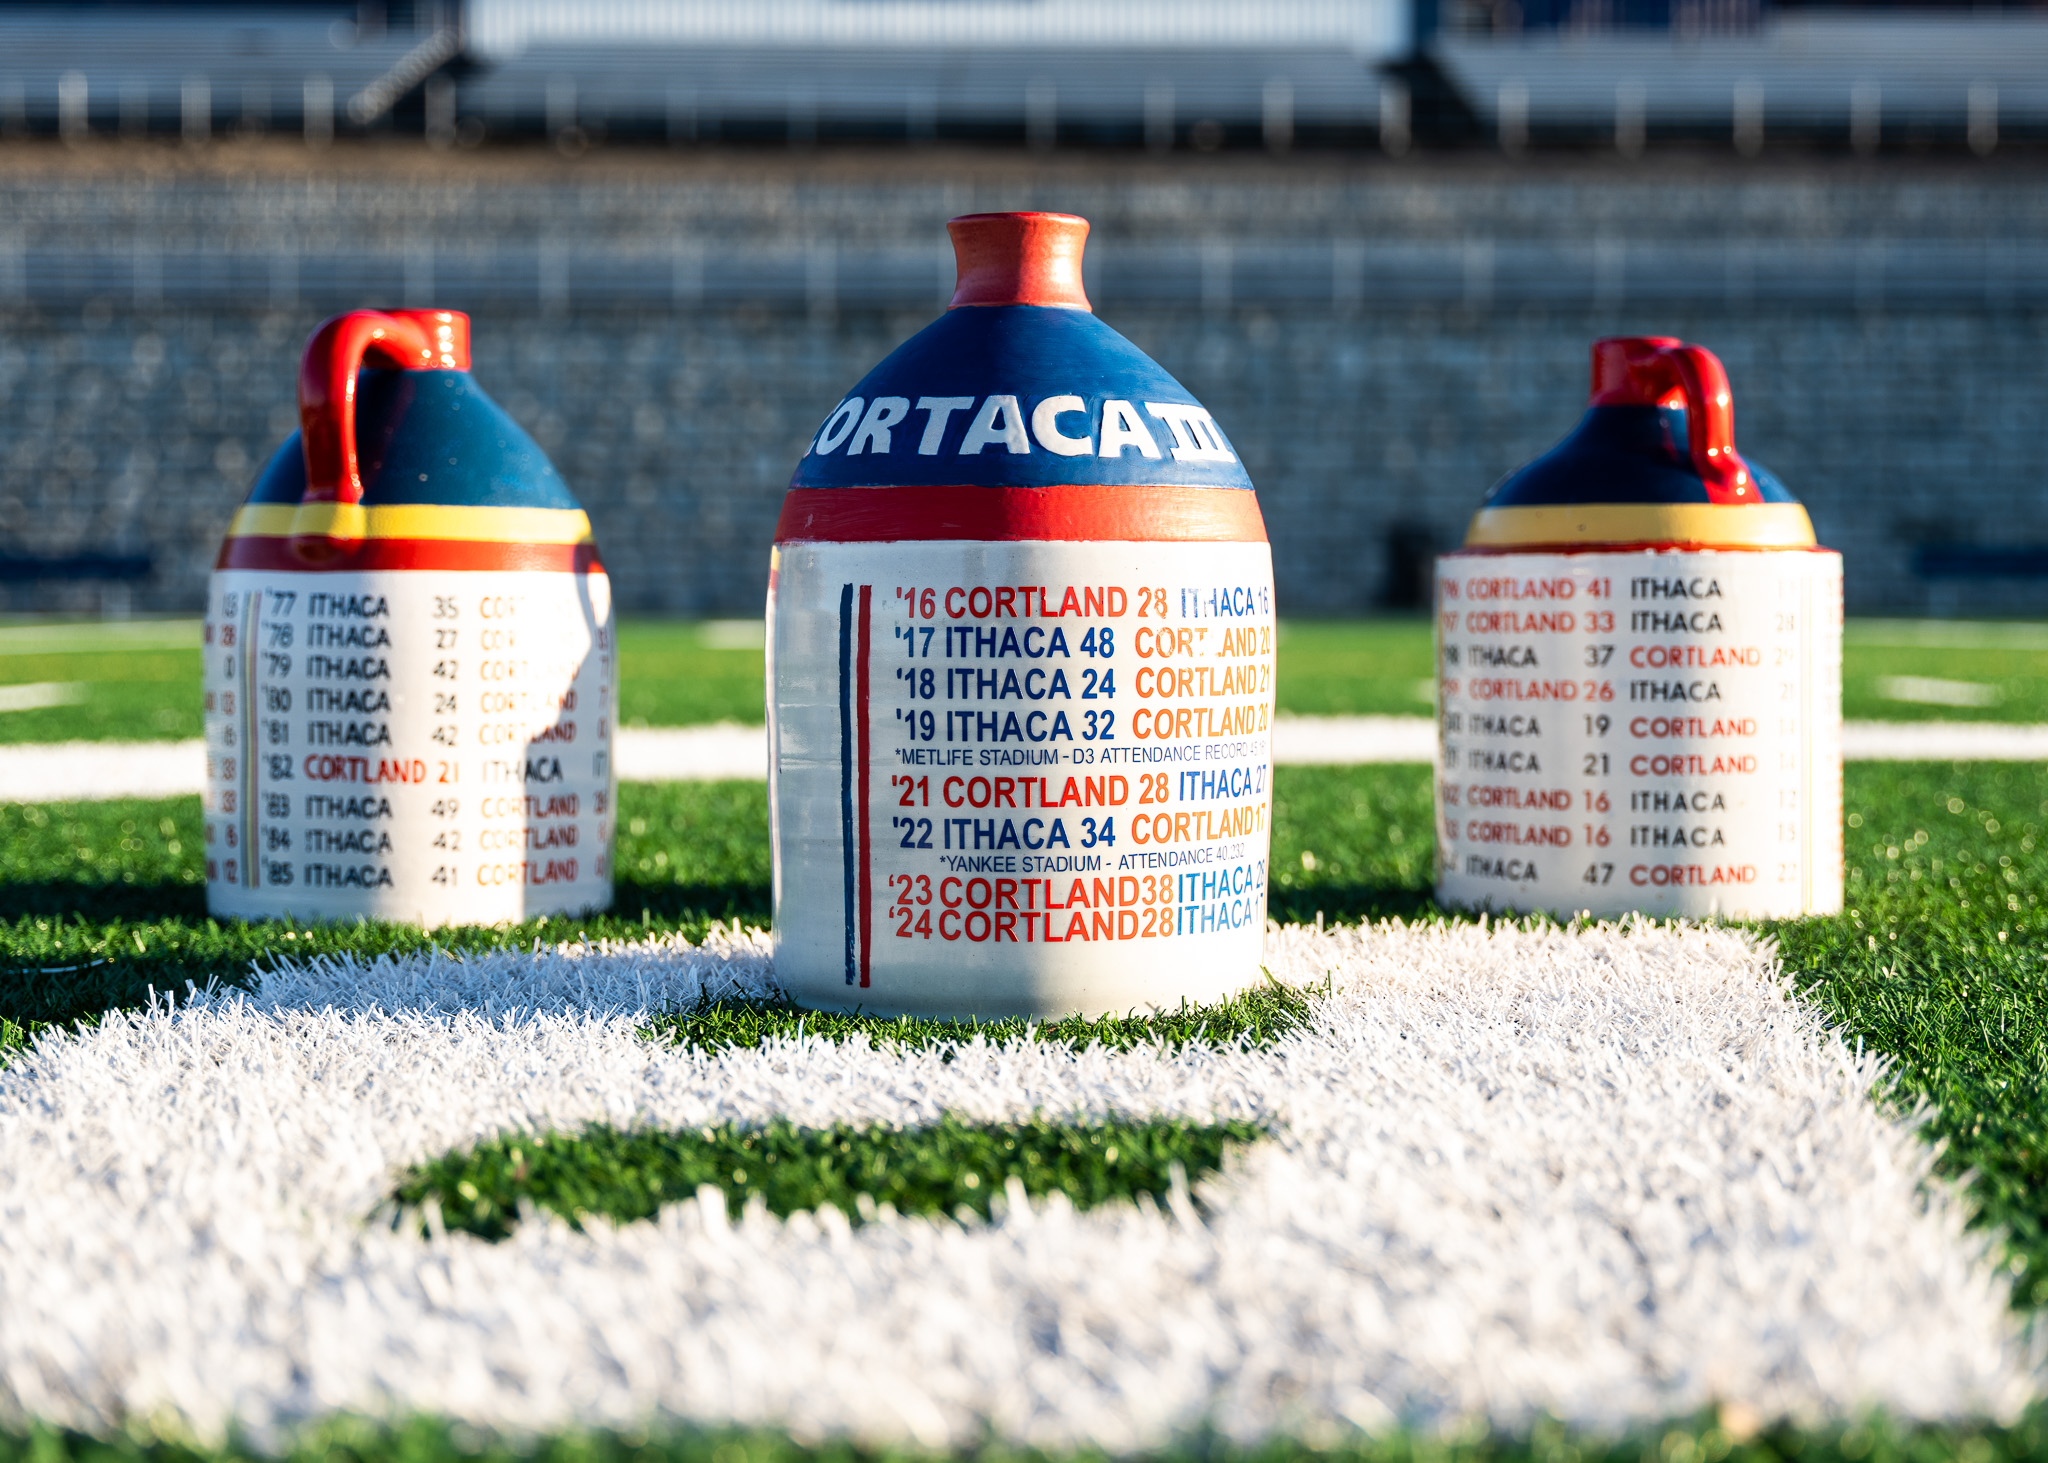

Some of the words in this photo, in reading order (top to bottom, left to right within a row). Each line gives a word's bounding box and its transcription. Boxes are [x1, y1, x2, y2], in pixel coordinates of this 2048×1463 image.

[266, 586, 296, 617] '77
[308, 593, 390, 618] ITHACA
[432, 595, 458, 619] 35
[896, 586, 936, 619] '16
[944, 586, 1128, 619] CORTLAND
[1137, 586, 1168, 620] 28
[1180, 586, 1255, 619] ITHACA
[1258, 586, 1269, 617] 16
[1466, 577, 1575, 600] CORTLAND
[1585, 577, 1612, 599] 41
[1630, 577, 1723, 600] ITHACA
[261, 619, 294, 648] '78
[308, 624, 391, 650] ITHACA
[436, 628, 457, 650] 27
[1466, 611, 1577, 634] CORTLAND
[1583, 611, 1616, 634] 33
[1630, 610, 1725, 634] ITHACA
[895, 626, 935, 658] '17
[946, 626, 1071, 659] ITHACA
[1080, 626, 1115, 659] 48
[1260, 625, 1271, 656] 20
[1468, 644, 1539, 668] ITHACA
[1584, 645, 1615, 668] 37
[1629, 645, 1760, 669] CORTLAND
[261, 650, 292, 679] '79
[307, 654, 391, 681] ITHACA
[432, 657, 458, 681] 42
[896, 667, 935, 700] '18
[947, 668, 1072, 700] ITHACA
[1081, 668, 1116, 700] 24
[1135, 664, 1257, 698] CORTLAND
[1260, 663, 1271, 693] 21
[261, 682, 293, 713] '80
[307, 686, 391, 714] ITHACA
[434, 691, 457, 714] 24
[1469, 678, 1578, 702] CORTLAND
[1582, 679, 1616, 702] 26
[1630, 679, 1722, 702] ITHACA
[261, 716, 290, 745] '81
[307, 720, 391, 747] ITHACA
[431, 724, 458, 748] 42
[896, 708, 935, 742] '19
[947, 710, 1074, 743] ITHACA
[1081, 709, 1115, 741] 32
[1132, 705, 1256, 740] CORTLAND
[1258, 702, 1269, 732] 20
[1468, 713, 1542, 738] ITHACA
[1584, 713, 1611, 737] 19
[1629, 716, 1758, 739] CORTLAND
[262, 751, 295, 782] '82
[303, 753, 426, 784] CORTLAND
[437, 760, 459, 784] 21
[482, 754, 566, 785] ITHACA
[979, 748, 1059, 766] STADIUM
[1073, 747, 1095, 764] D3
[1100, 745, 1201, 764] ATTENDANCE
[1205, 741, 1248, 760] RECORD
[1467, 750, 1541, 775] ITHACA
[1583, 752, 1611, 776] 21
[1629, 754, 1757, 777] CORTLAND
[891, 775, 929, 807] '21
[942, 775, 1129, 808] CORTLAND
[1138, 772, 1170, 804] 28
[1179, 767, 1252, 801] ITHACA
[1255, 764, 1267, 794] 27
[1466, 785, 1572, 811] CORTLAND
[1583, 789, 1611, 812] 16
[1630, 790, 1726, 813] ITHACA
[305, 795, 393, 821] ITHACA
[431, 796, 458, 821] 49
[480, 791, 580, 821] CORTLAND
[305, 828, 392, 855] ITHACA
[432, 829, 461, 854] 42
[479, 823, 580, 851] CORTLAND
[892, 816, 933, 849] '22
[943, 818, 1071, 850] ITHACA
[1080, 816, 1116, 848] 34
[1131, 806, 1254, 846] CORTLAND
[1255, 802, 1266, 833] 17
[1466, 819, 1572, 848] CORTLAND
[1584, 824, 1611, 848] 16
[1630, 825, 1726, 848] ITHACA
[304, 862, 394, 889] ITHACA
[431, 864, 457, 888] 41
[476, 855, 579, 887] CORTLAND
[1022, 854, 1102, 873] STADIUM
[1118, 847, 1213, 870] ATTENDANCE
[1466, 855, 1539, 884] ITHACA
[1583, 861, 1616, 886] 47
[1629, 863, 1757, 887] CORTLAND
[939, 875, 1140, 910] CORTLAND
[1141, 874, 1174, 906] 38
[1177, 864, 1253, 904] ITHACA
[938, 908, 1139, 943] CORTLAND
[1141, 906, 1175, 938] 28
[1177, 897, 1253, 936] ITHACA
